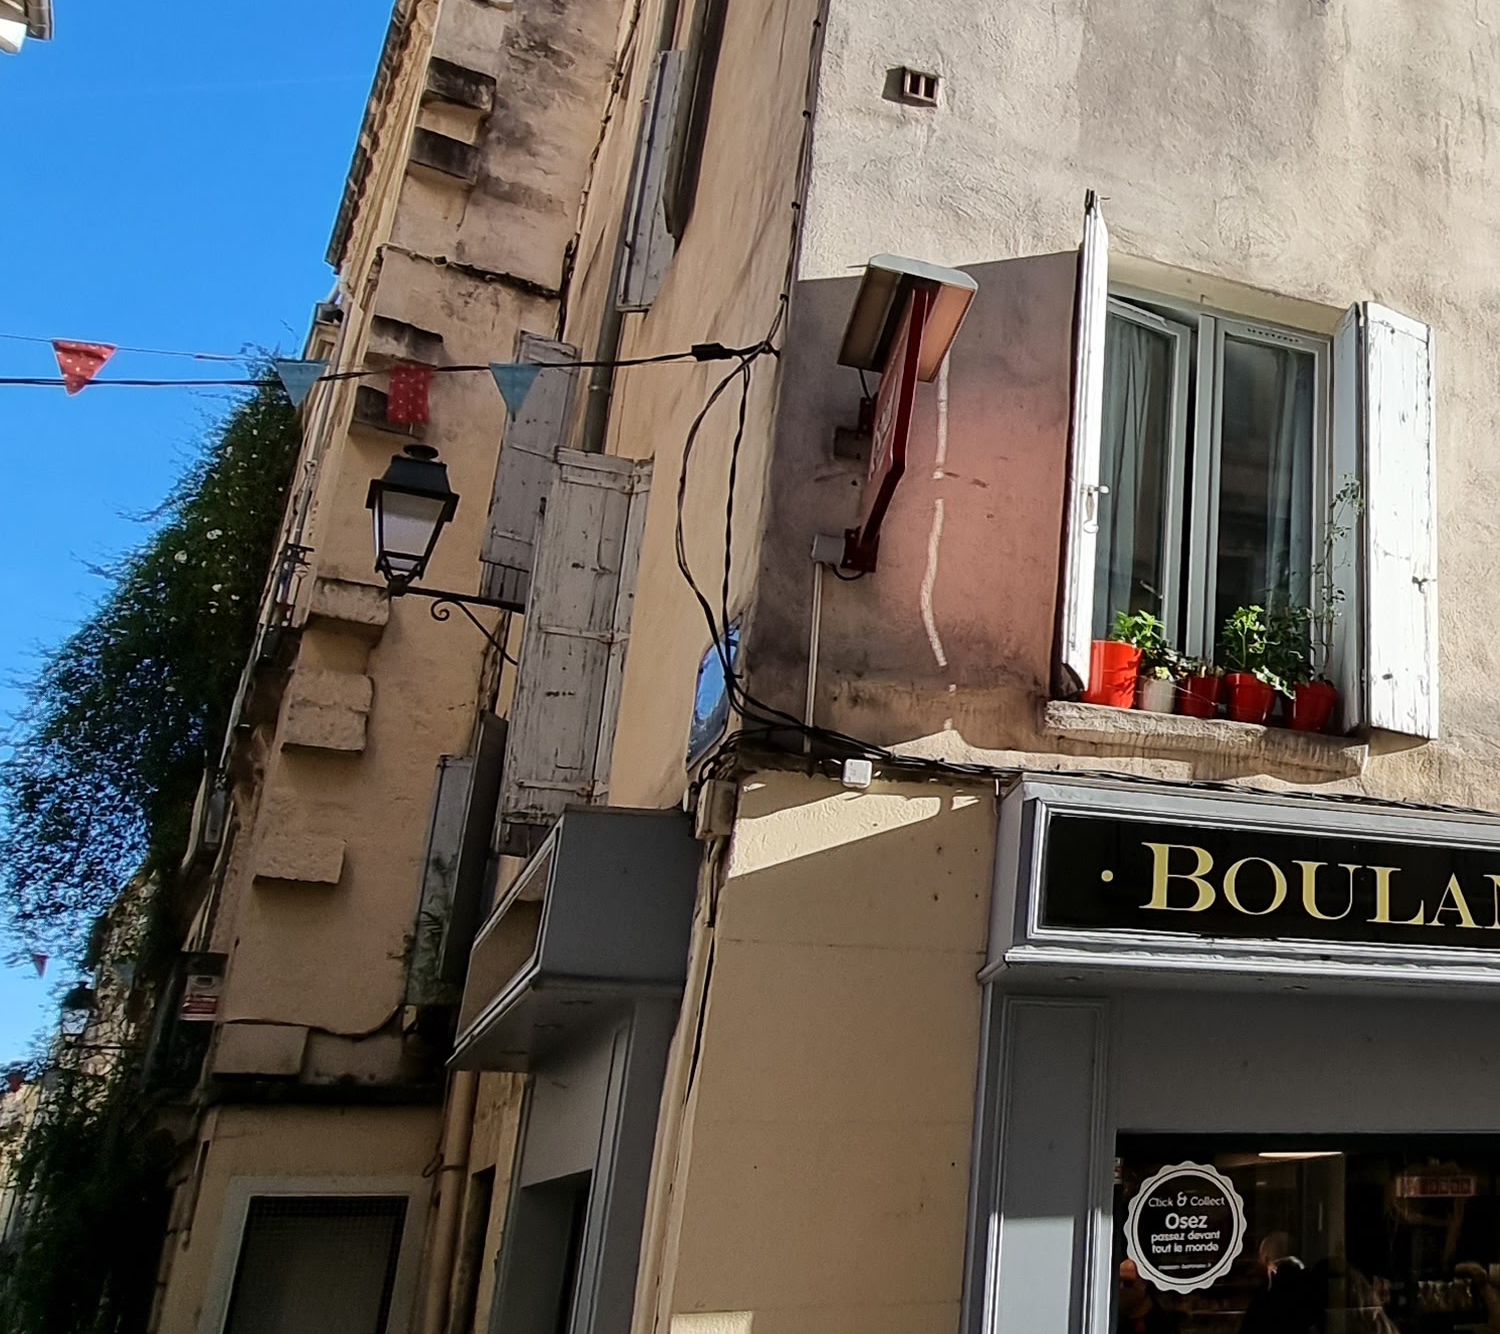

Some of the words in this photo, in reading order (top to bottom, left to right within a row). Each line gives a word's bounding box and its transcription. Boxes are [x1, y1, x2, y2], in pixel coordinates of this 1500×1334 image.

[1148, 1197, 1173, 1207] Click
[1190, 1196, 1225, 1206] Collect
[1165, 1212, 1208, 1229] Osez
[1151, 1232, 1185, 1244] passez
[1187, 1230, 1220, 1240] devant
[1152, 1243, 1171, 1253] tout
[1185, 1242, 1219, 1252] monde
